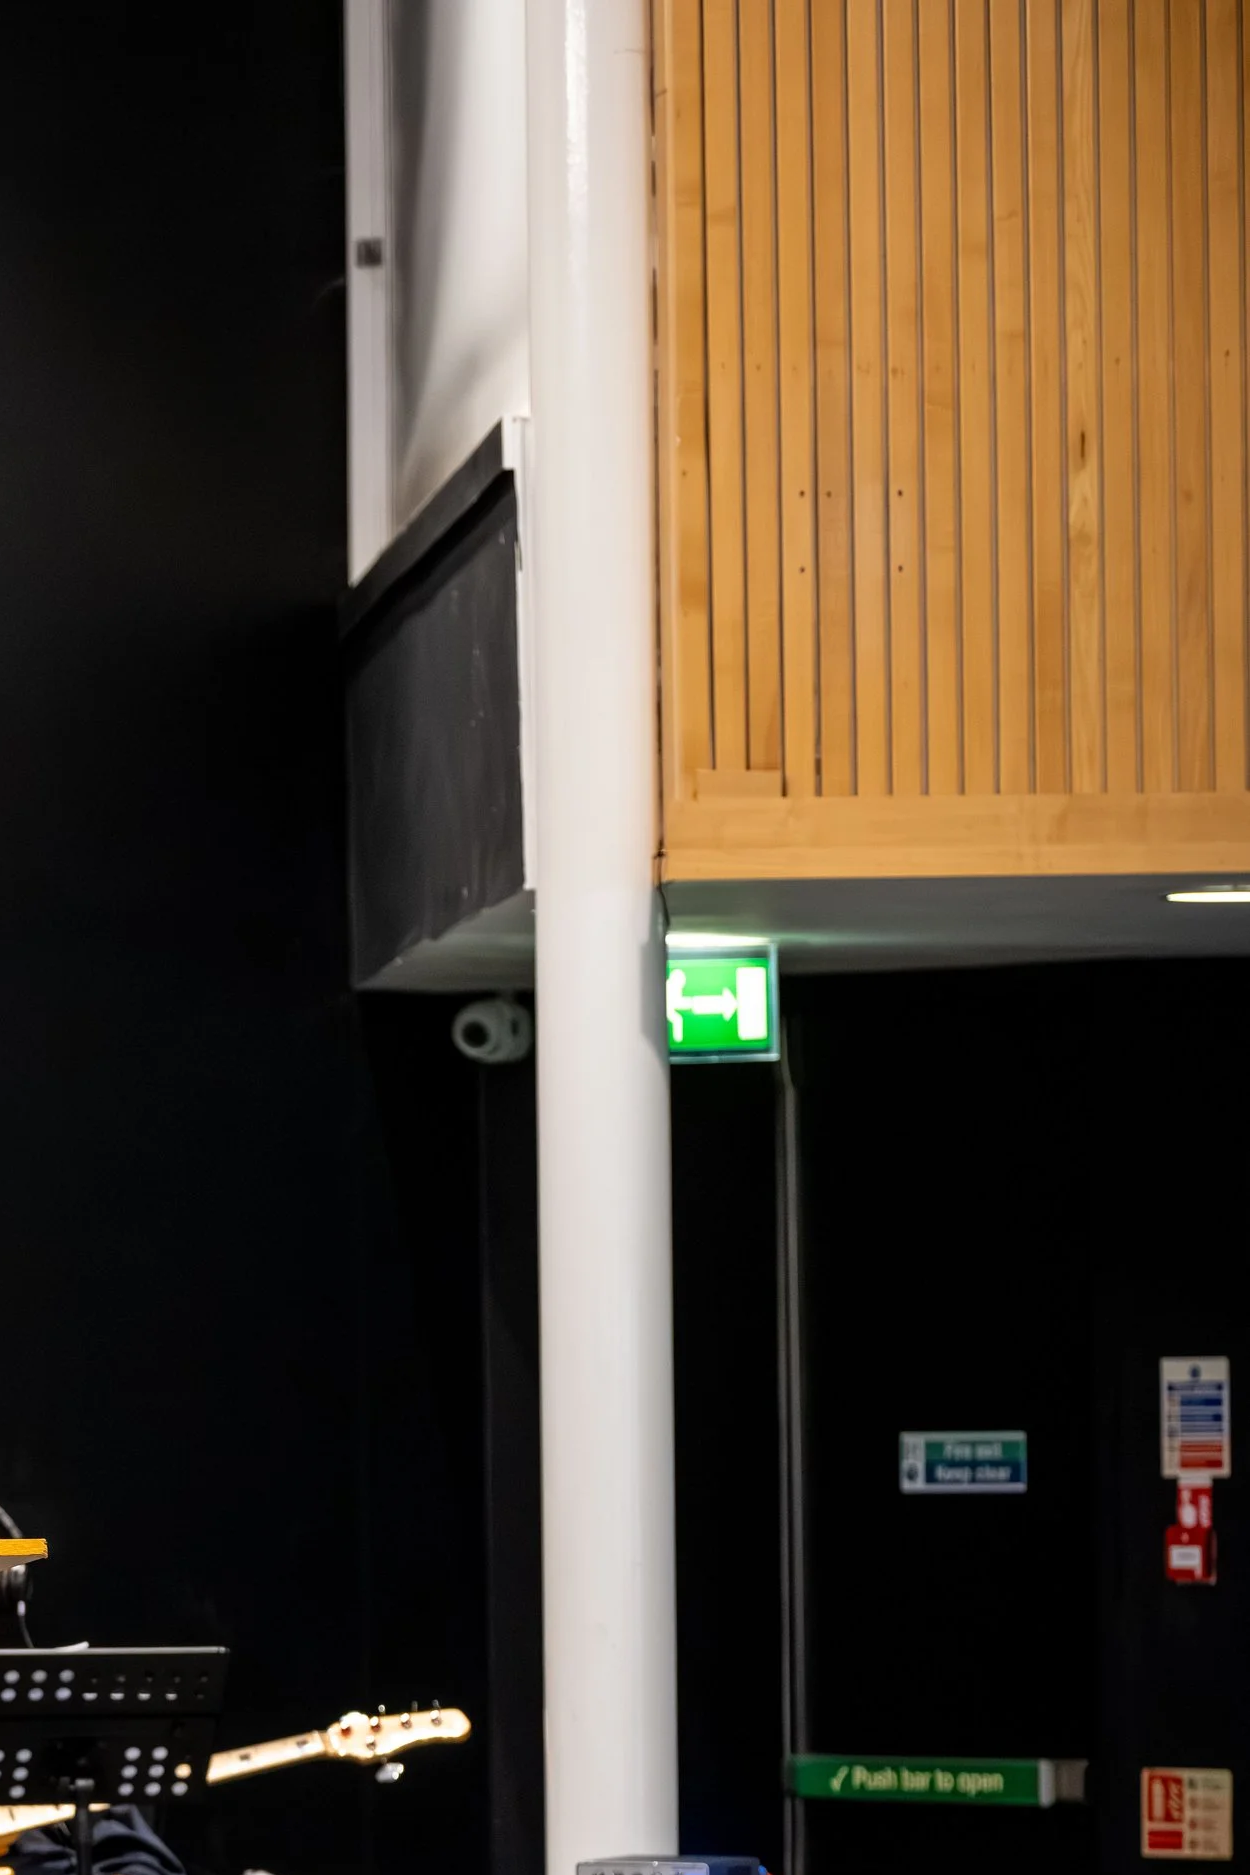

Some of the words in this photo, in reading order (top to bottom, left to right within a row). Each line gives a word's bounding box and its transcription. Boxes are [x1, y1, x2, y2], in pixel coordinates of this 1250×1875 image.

[852, 1765, 897, 1791] Push
[900, 1767, 932, 1791] bar
[934, 1769, 954, 1792] to
[956, 1771, 1003, 1797] open
